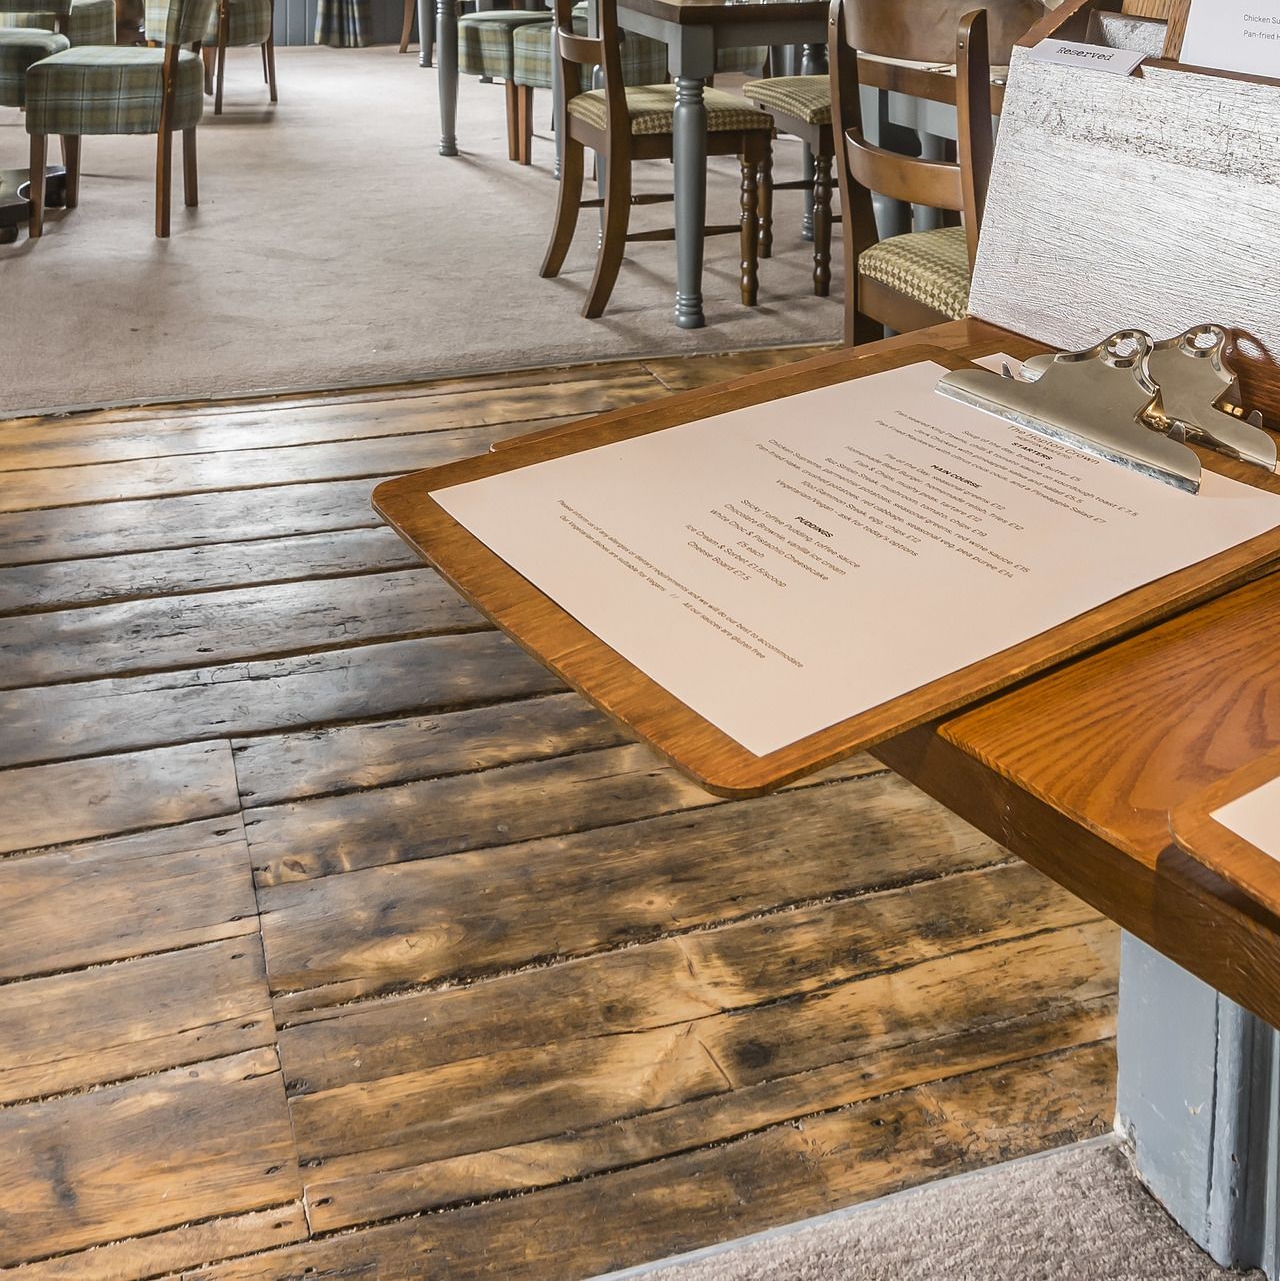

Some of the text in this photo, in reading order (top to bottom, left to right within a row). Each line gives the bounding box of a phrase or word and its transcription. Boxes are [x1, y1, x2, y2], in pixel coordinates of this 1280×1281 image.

[1244, 14, 1271, 24] Chicken
[1244, 29, 1275, 40] Pan-fried
[1056, 47, 1114, 60] Reserved
[1011, 442, 1054, 460] STARTERS
